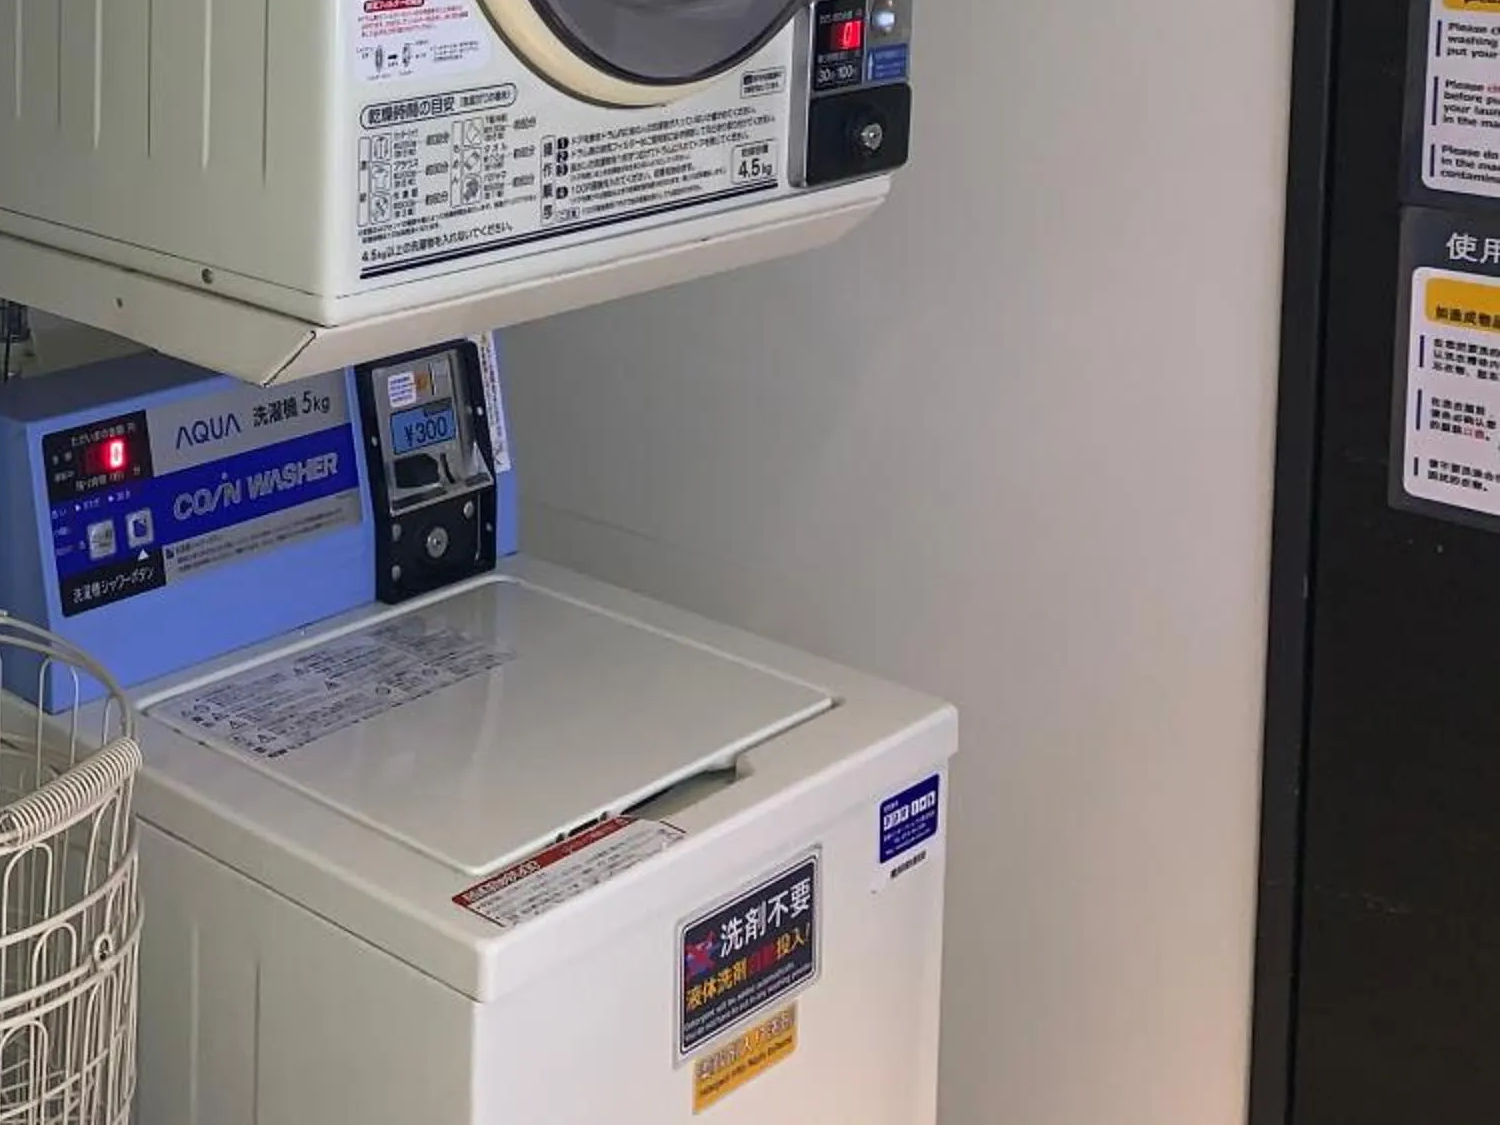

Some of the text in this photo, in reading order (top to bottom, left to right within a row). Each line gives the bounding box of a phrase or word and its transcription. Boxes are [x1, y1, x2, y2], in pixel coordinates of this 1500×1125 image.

[1448, 22, 1488, 34] Please
[1447, 35, 1499, 49] washing
[1445, 79, 1484, 92] Please
[1443, 91, 1482, 103] before
[1441, 144, 1480, 157] Please
[176, 390, 331, 449] AQUA 洗濯機 5kg
[404, 416, 448, 448] ¥300
[109, 441, 124, 468] 0
[173, 452, 338, 521] COIN WASHER
[720, 877, 811, 958] 洗剤不要
